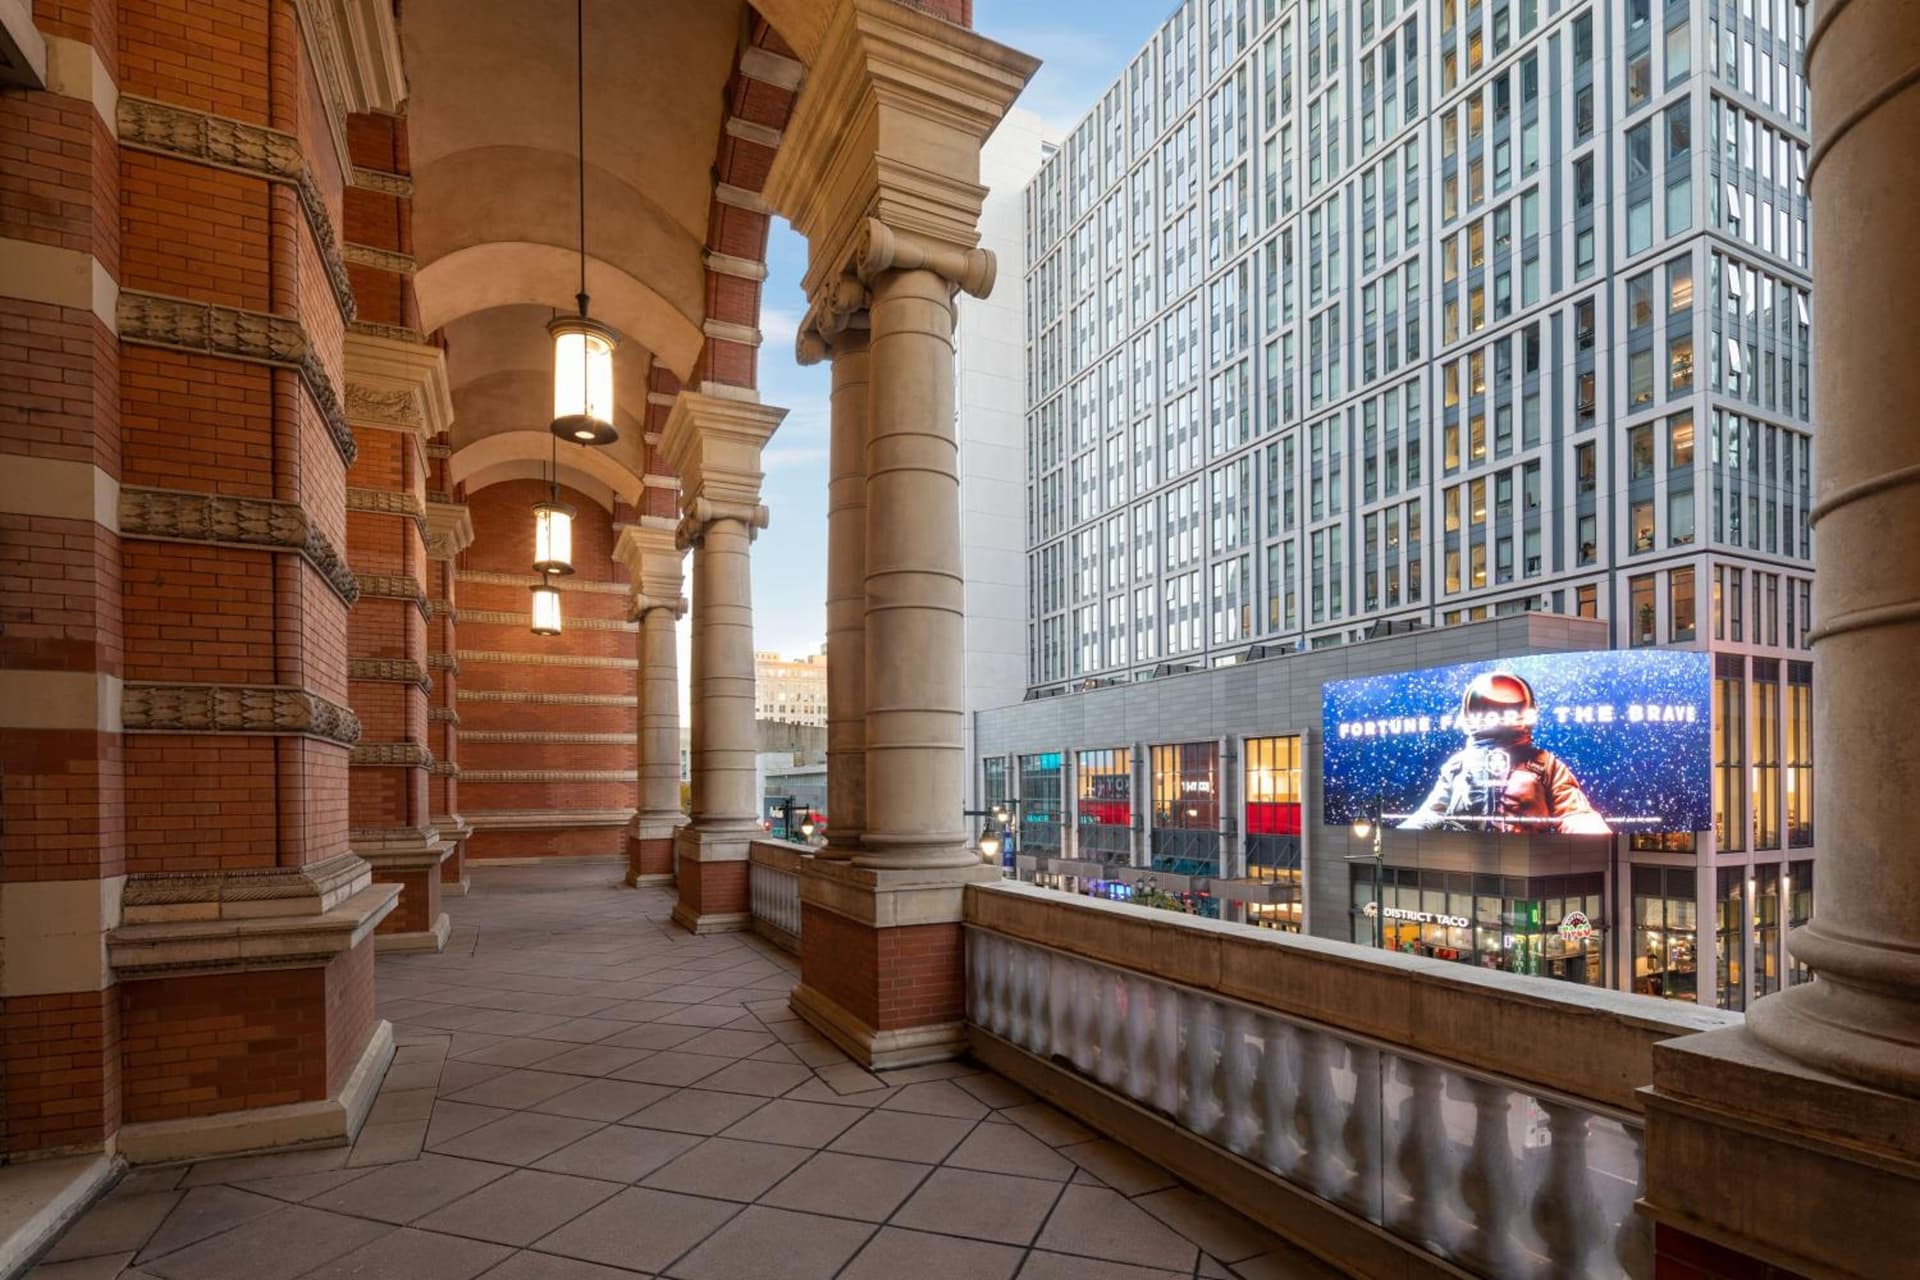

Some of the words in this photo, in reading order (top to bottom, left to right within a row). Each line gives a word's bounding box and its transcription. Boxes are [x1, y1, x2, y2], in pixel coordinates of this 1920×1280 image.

[1338, 715, 1431, 739] FORTUNE
[1554, 704, 1615, 724] THE
[1627, 703, 1697, 724] BRAVE
[1383, 907, 1433, 922] DISTRICT
[1434, 914, 1470, 928] TACO
